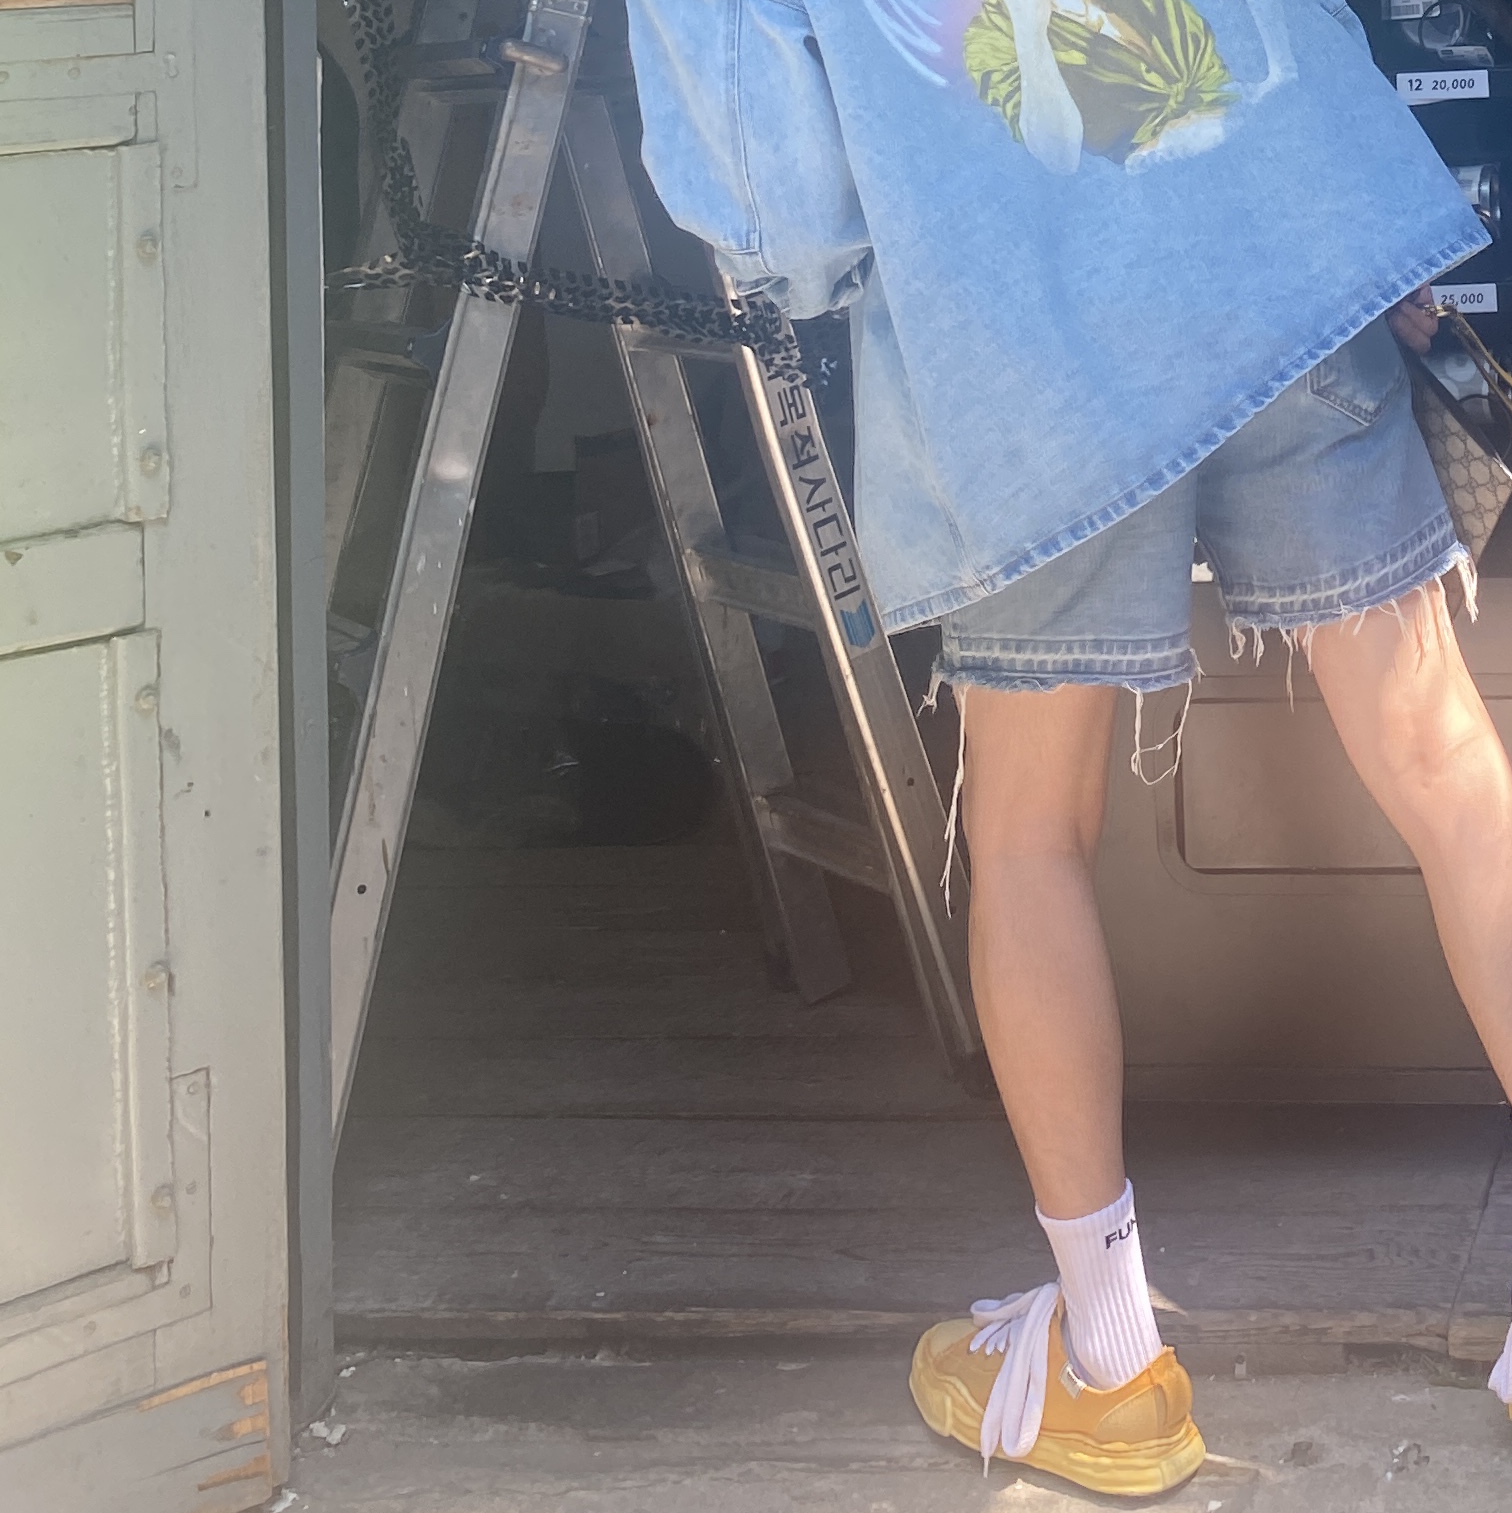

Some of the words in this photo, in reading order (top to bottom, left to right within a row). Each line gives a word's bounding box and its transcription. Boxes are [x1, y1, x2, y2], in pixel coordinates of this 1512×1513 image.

[1407, 78, 1423, 92] 12
[1431, 78, 1475, 91] 20,000
[1440, 293, 1484, 307] 25,000
